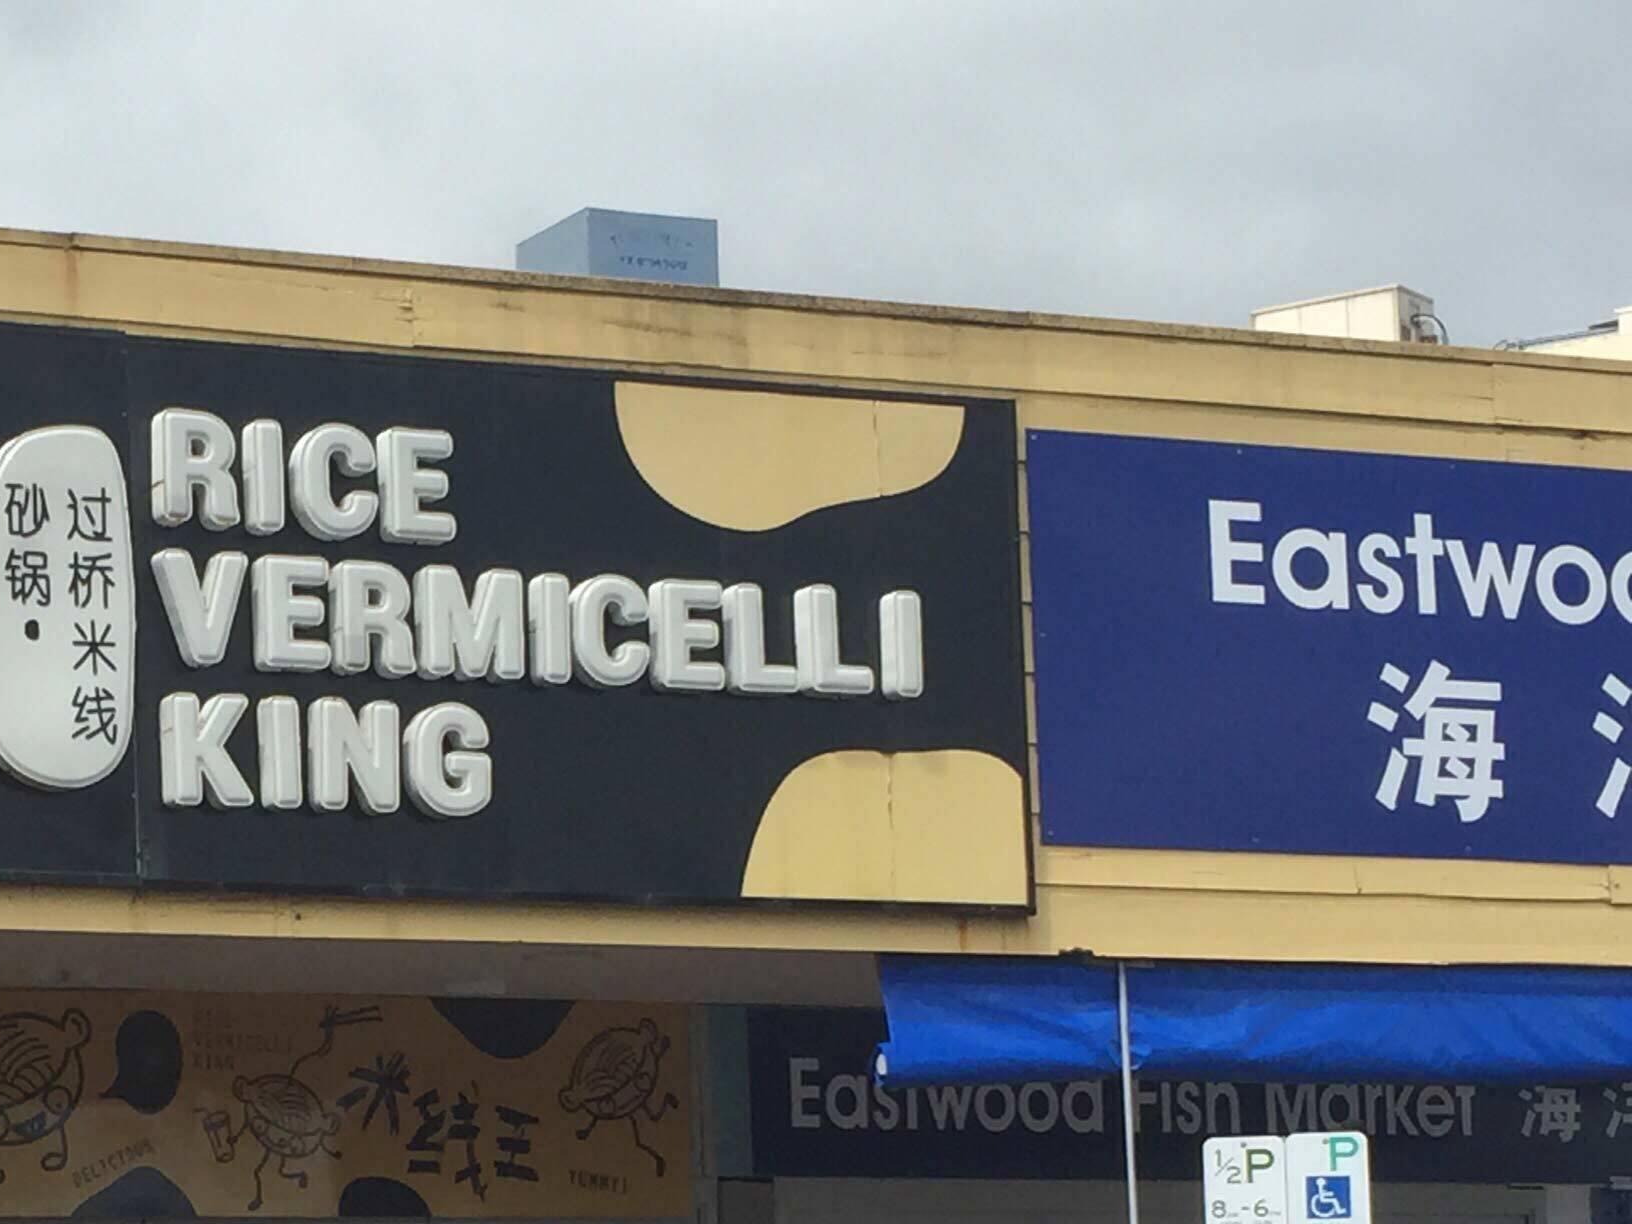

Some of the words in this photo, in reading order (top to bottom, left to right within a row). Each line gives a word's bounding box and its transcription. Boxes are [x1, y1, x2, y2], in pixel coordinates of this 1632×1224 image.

[151, 407, 457, 546] RICE
[68, 487, 118, 745] 过桥米线
[151, 549, 922, 700] VERMICELLI
[162, 692, 492, 818] KING
[336, 1051, 540, 1202] 米线王
[1329, 1136, 1360, 1172] P
